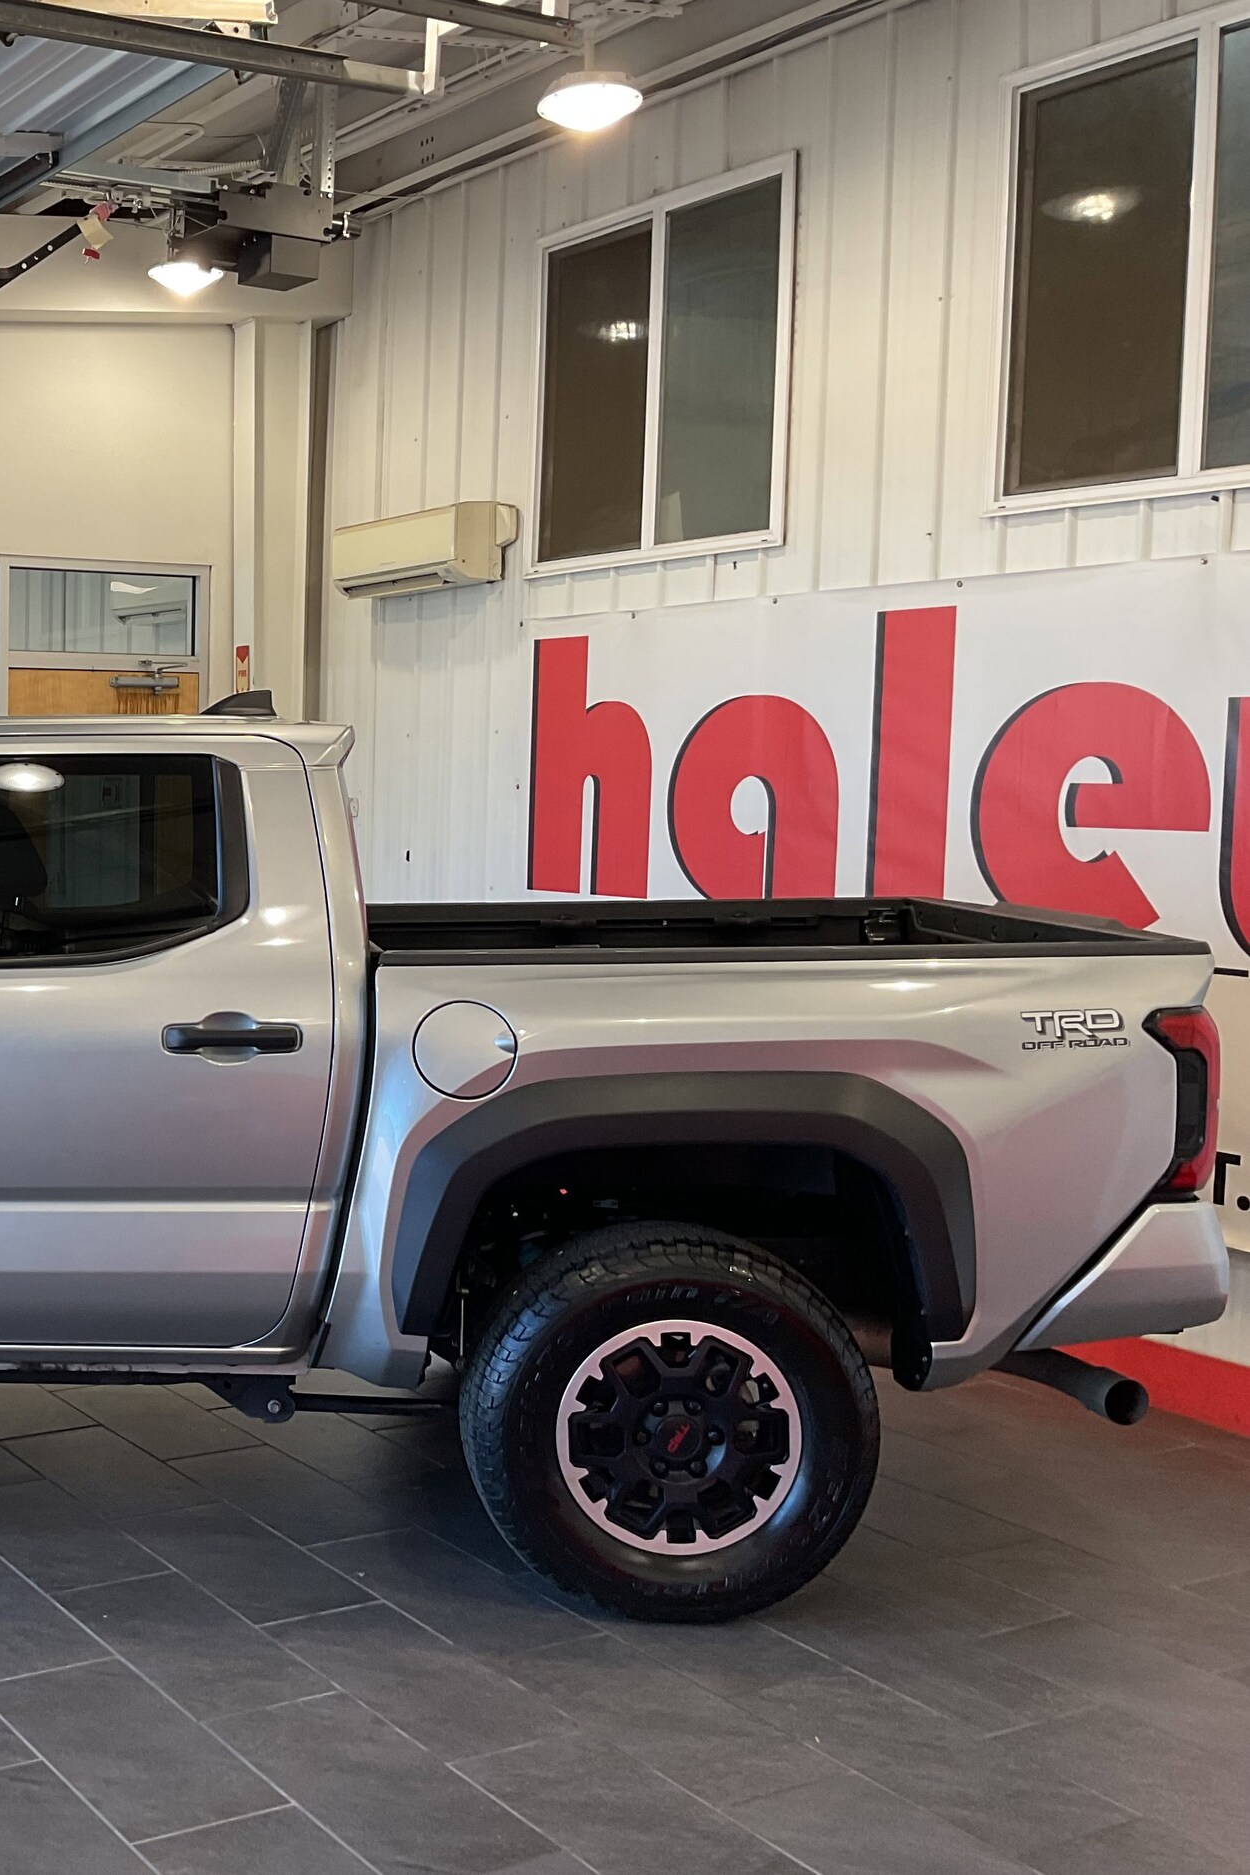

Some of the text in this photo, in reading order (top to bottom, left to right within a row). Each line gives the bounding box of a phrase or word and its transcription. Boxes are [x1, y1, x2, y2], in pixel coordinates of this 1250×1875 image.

[1020, 1008, 1124, 1040] TRD
[1021, 1037, 1130, 1051] OFF ROAD
